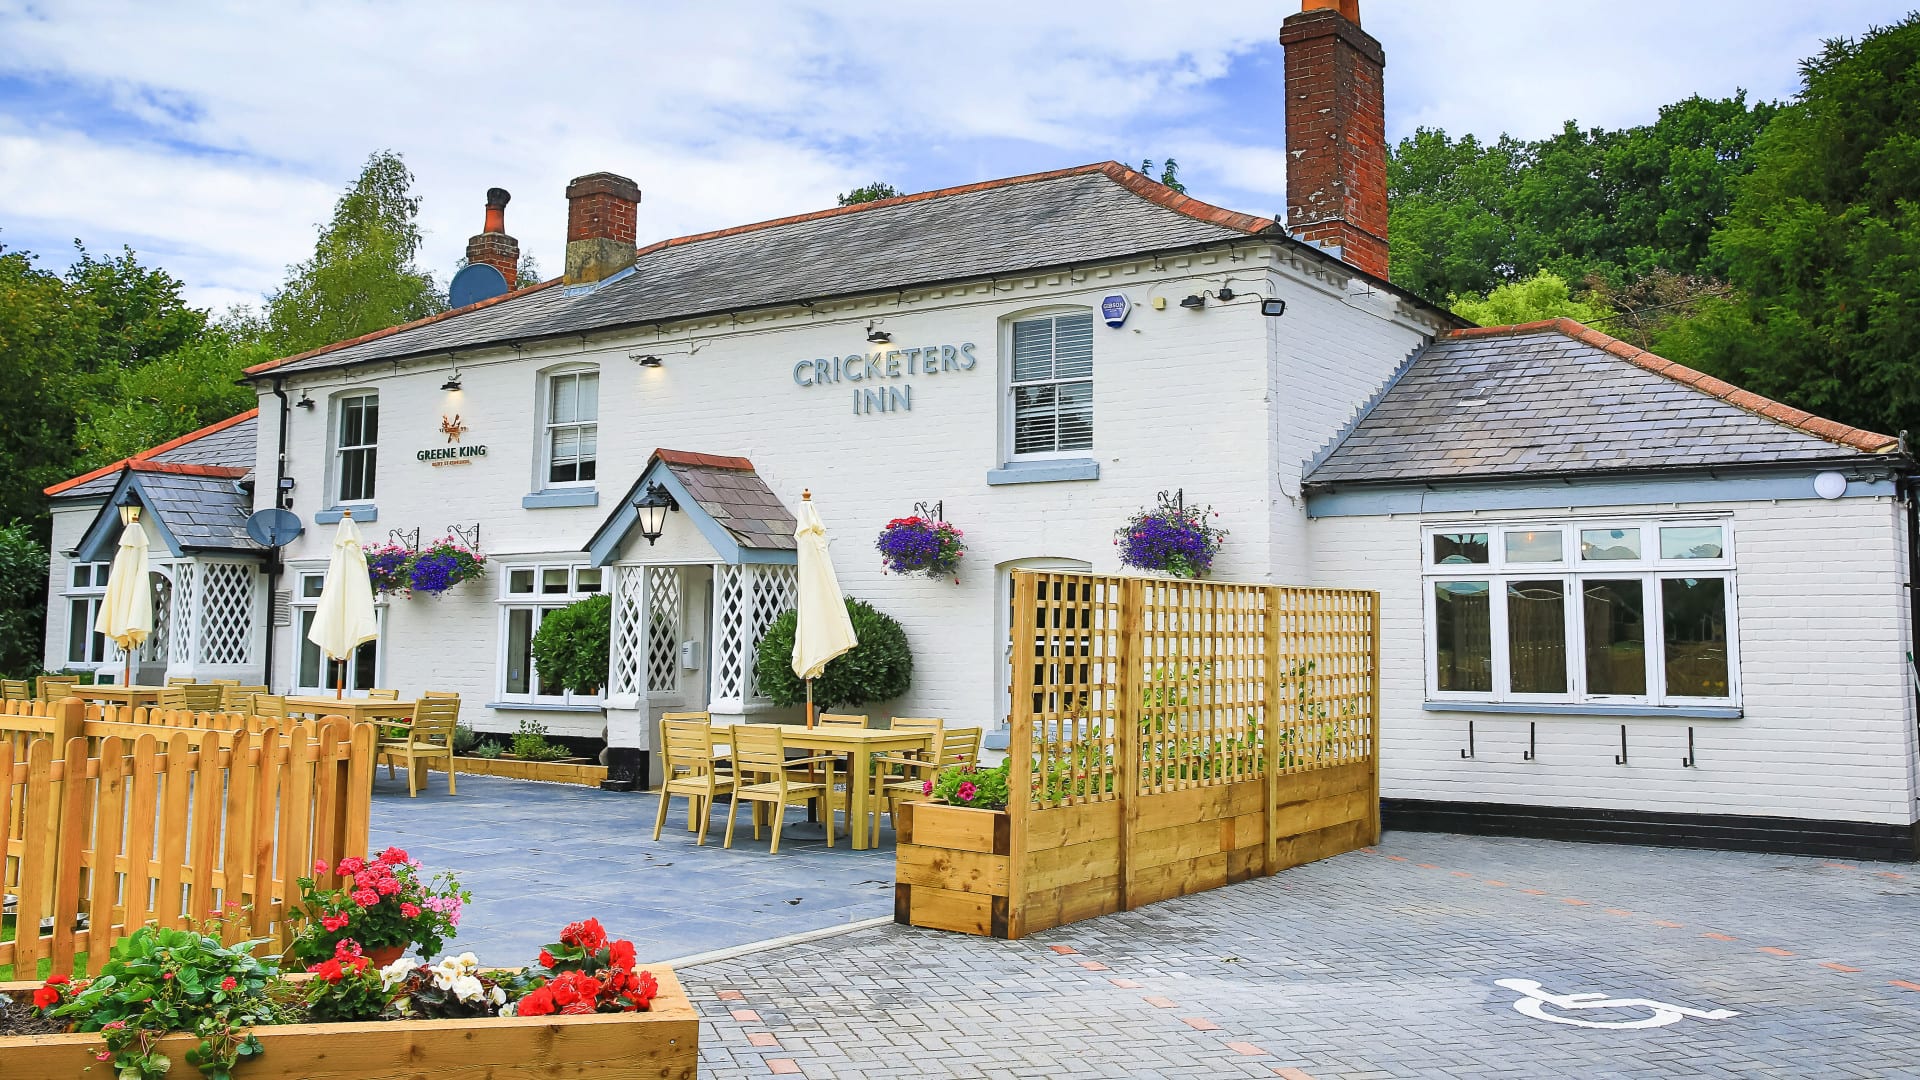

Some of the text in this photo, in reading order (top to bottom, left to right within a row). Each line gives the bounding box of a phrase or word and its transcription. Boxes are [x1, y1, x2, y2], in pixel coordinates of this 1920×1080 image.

[793, 343, 975, 386] CRICKETERS
[853, 384, 911, 415] INN
[417, 445, 486, 461] GREENE KING
